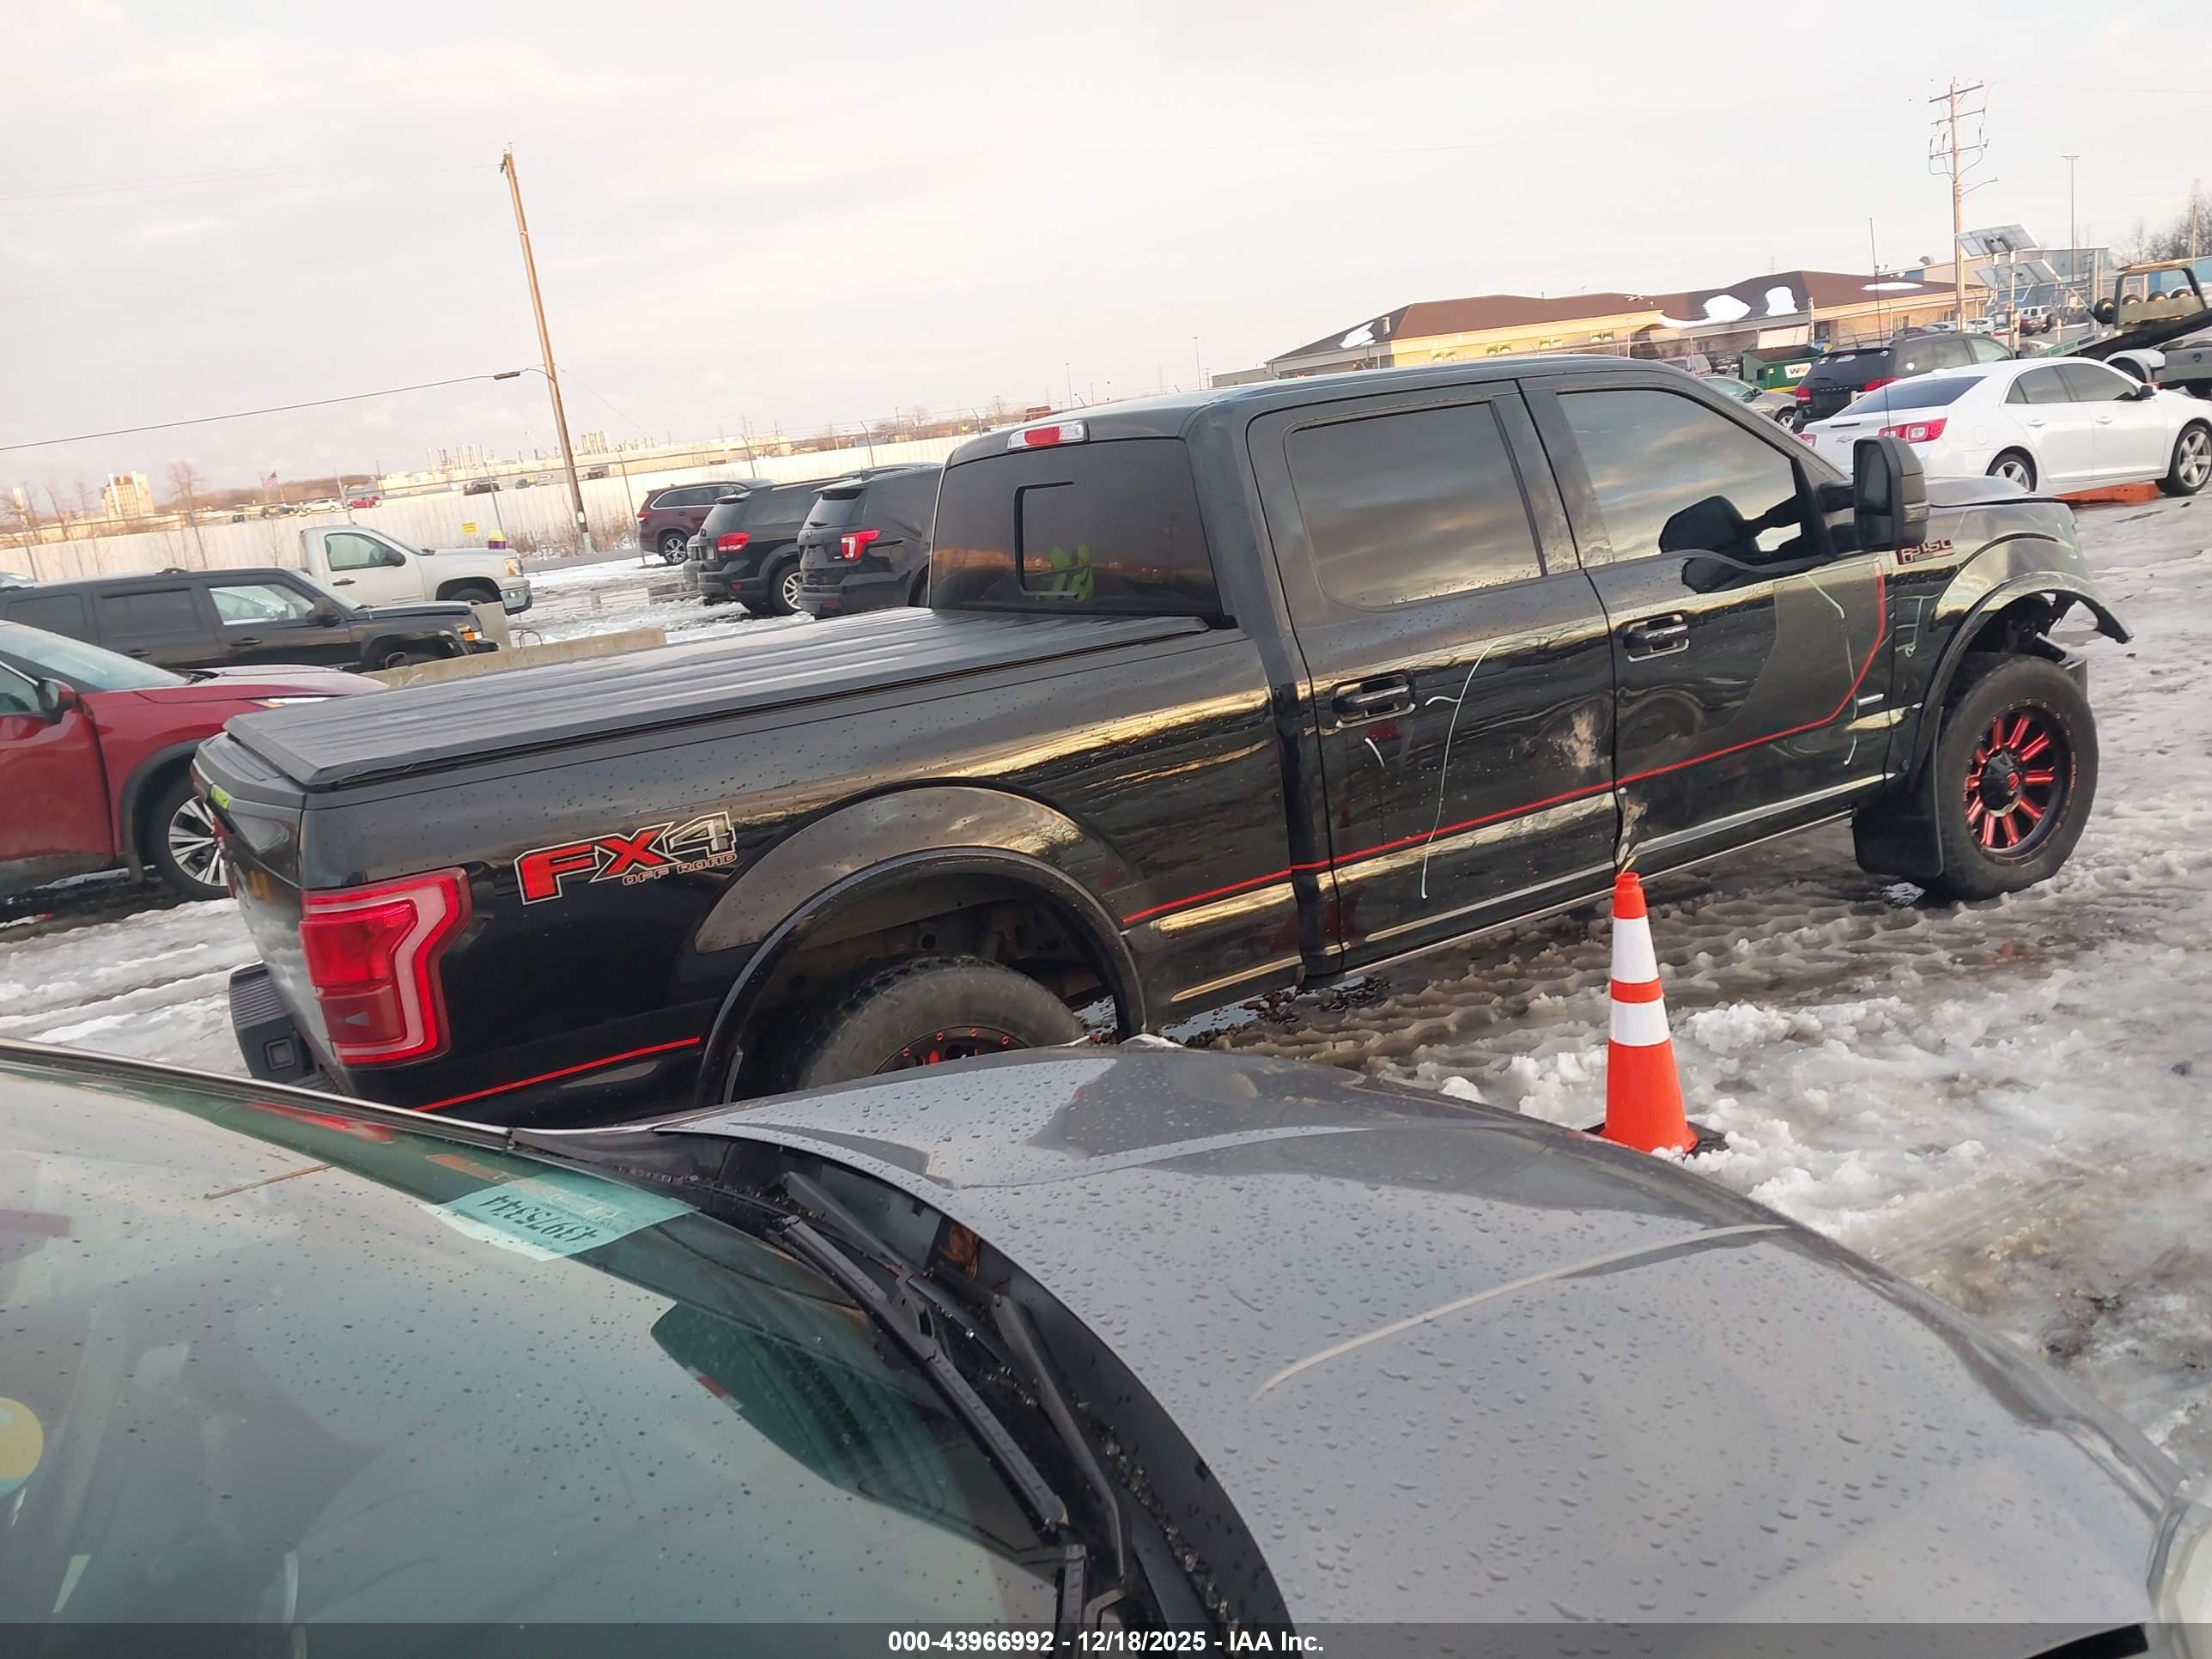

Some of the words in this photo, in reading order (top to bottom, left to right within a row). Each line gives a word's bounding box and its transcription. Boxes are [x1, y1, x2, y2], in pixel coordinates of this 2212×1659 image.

[514, 811, 738, 906] FX4
[622, 867, 670, 886] OFF
[677, 853, 738, 874] ROAD
[477, 1194, 599, 1243] 43975344
